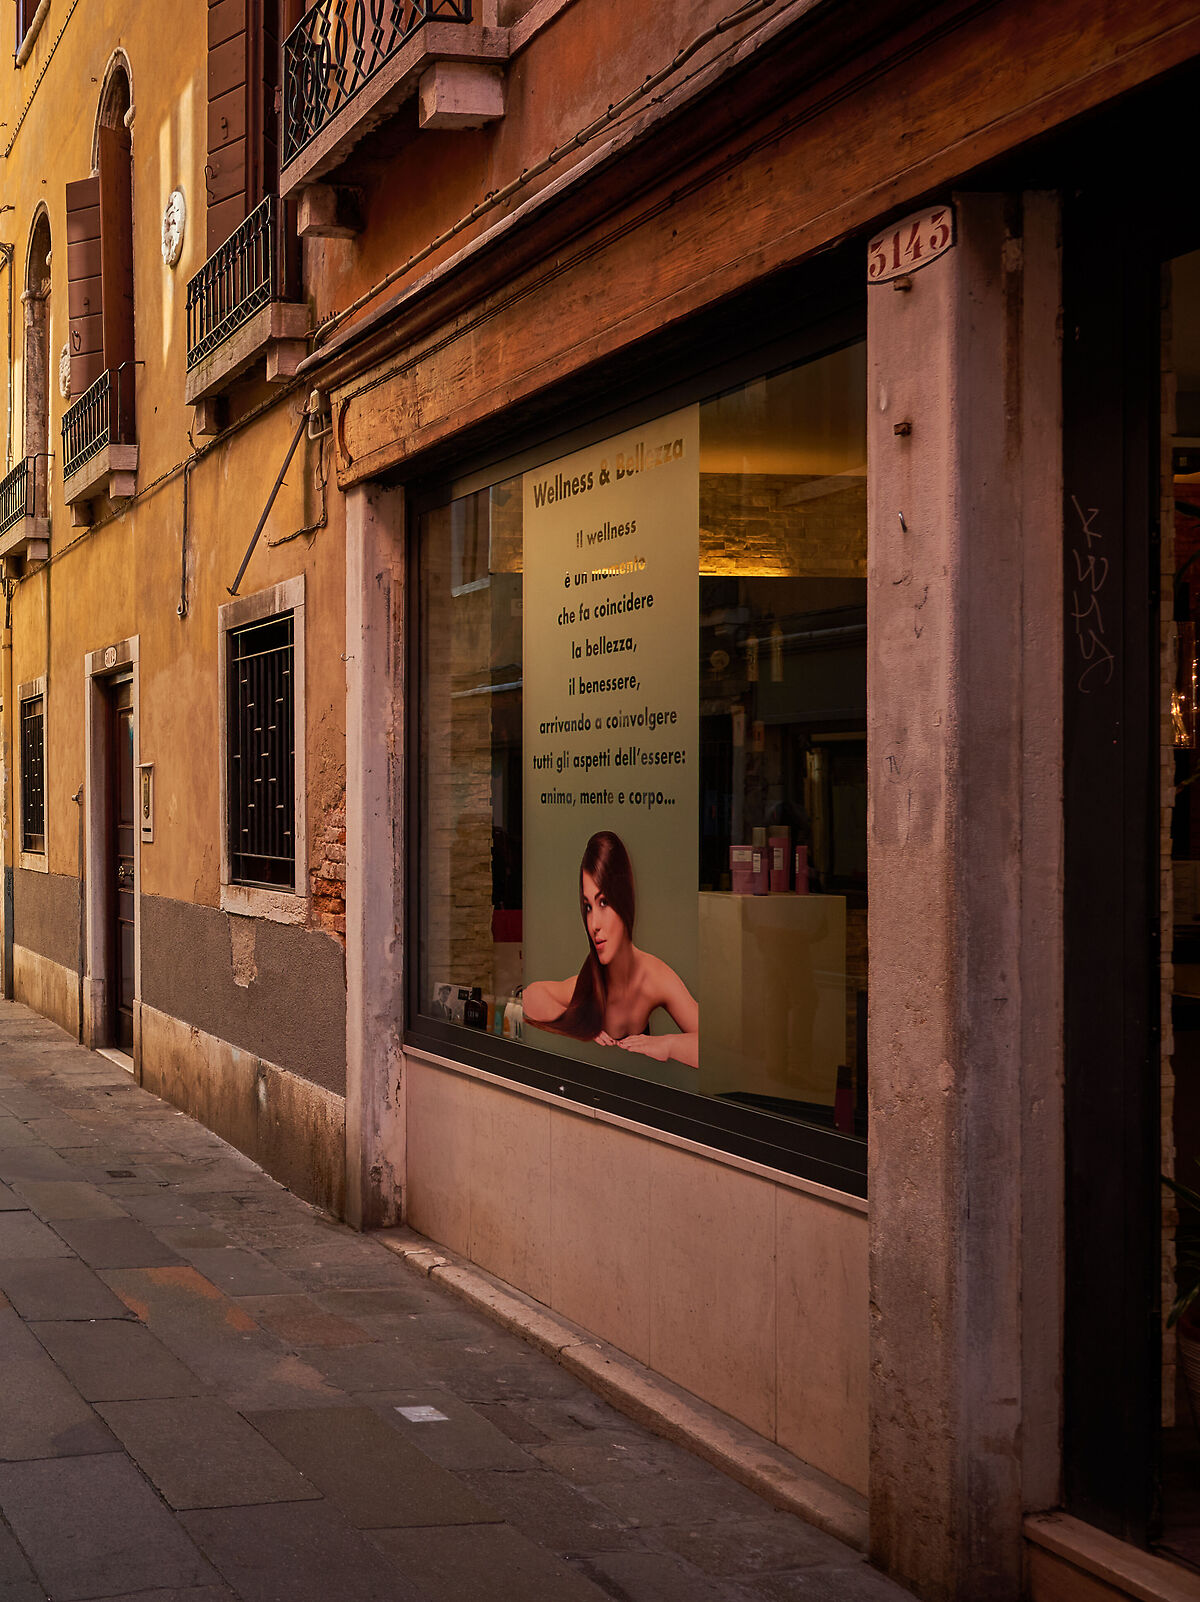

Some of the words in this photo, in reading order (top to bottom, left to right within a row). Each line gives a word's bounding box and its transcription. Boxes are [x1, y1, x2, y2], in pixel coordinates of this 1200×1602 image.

[869, 209, 950, 278] 3143
[533, 471, 594, 508] Wellness
[599, 458, 610, 486] &
[615, 438, 684, 480] Bellezza
[586, 520, 637, 545] wellness
[574, 572, 588, 586] un
[591, 555, 646, 582] momento
[557, 607, 576, 626] che
[579, 603, 590, 622] fa
[594, 592, 654, 618] coincidere
[571, 641, 582, 659] la
[585, 635, 637, 657] bellezza,
[568, 677, 575, 696] il
[579, 675, 641, 695] benessere,
[539, 712, 591, 734] arrivando
[595, 717, 602, 730] a
[606, 706, 677, 731] coinvolgere
[533, 752, 553, 769] tutti
[556, 750, 570, 773] gli
[573, 748, 611, 772] aspetti
[614, 746, 686, 766] dell'essere:
[540, 787, 577, 807] anima,
[580, 789, 614, 805] mente
[618, 791, 625, 805] e
[629, 791, 676, 810] corpo...
